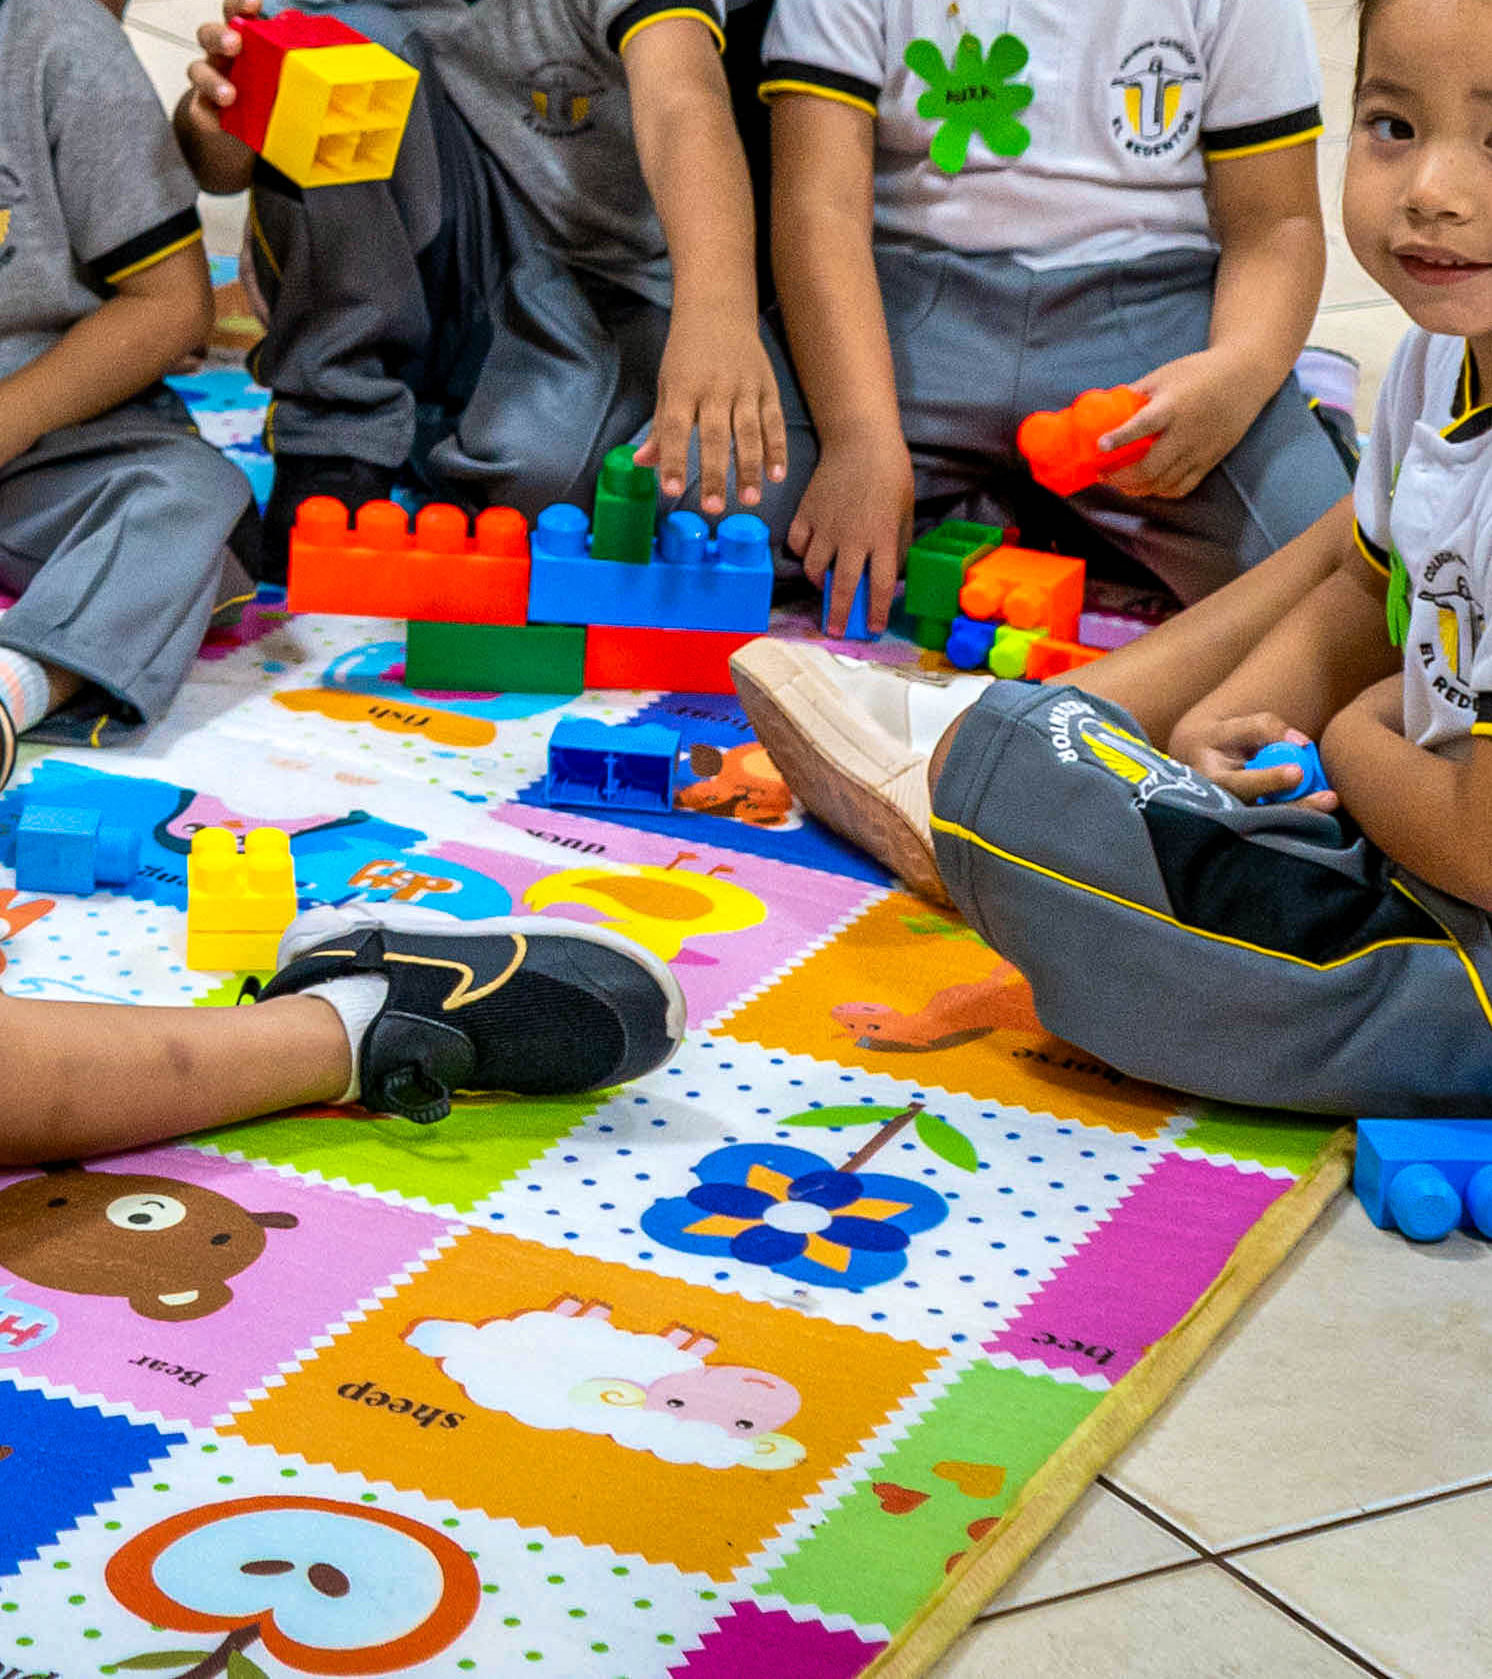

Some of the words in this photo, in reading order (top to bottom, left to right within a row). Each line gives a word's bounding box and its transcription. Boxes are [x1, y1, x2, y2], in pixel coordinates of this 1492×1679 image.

[1419, 643, 1435, 669] EL
[128, 1354, 209, 1389] Bear
[337, 1379, 467, 1432] sheep
